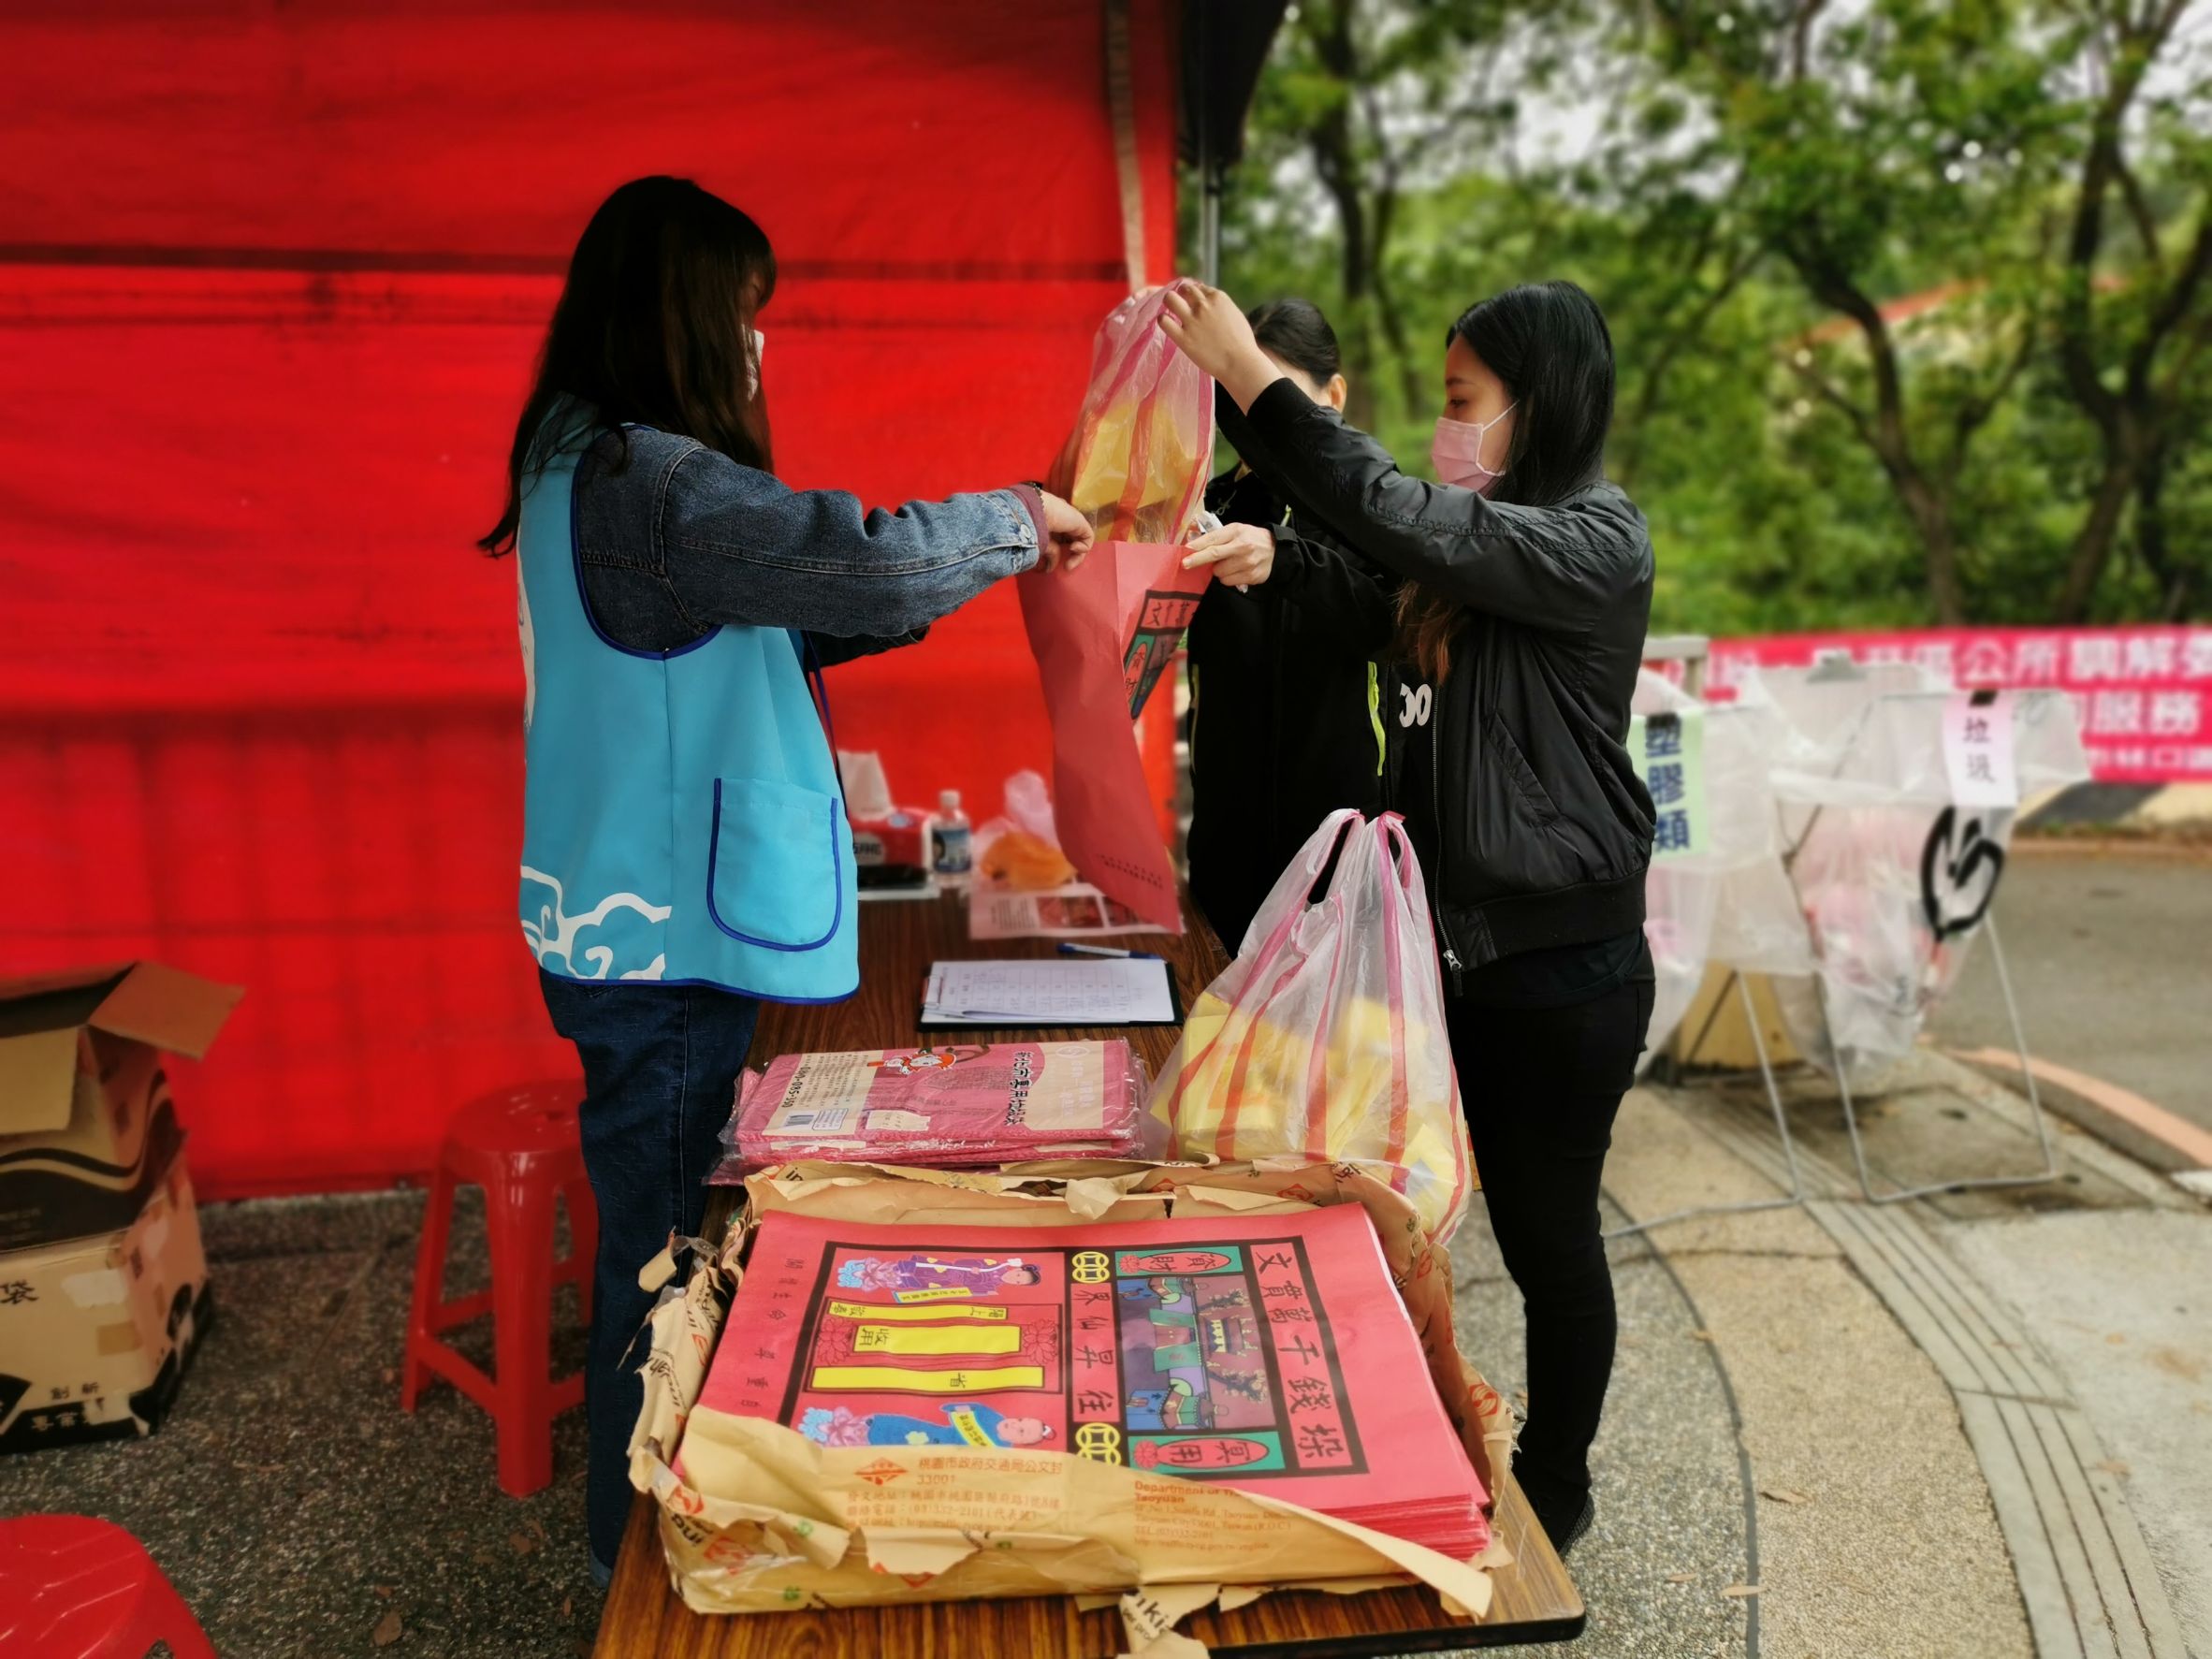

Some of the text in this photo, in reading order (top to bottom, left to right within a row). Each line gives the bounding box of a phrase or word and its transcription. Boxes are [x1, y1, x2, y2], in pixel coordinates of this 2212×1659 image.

[1964, 717, 1995, 784] 垃圾
[919, 1456, 1062, 1476] 桃園市政府交通局公文封
[916, 1474, 956, 1486] 33001
[1135, 1480, 1204, 1496] Department
[1135, 1492, 1186, 1505] Taoyuan
